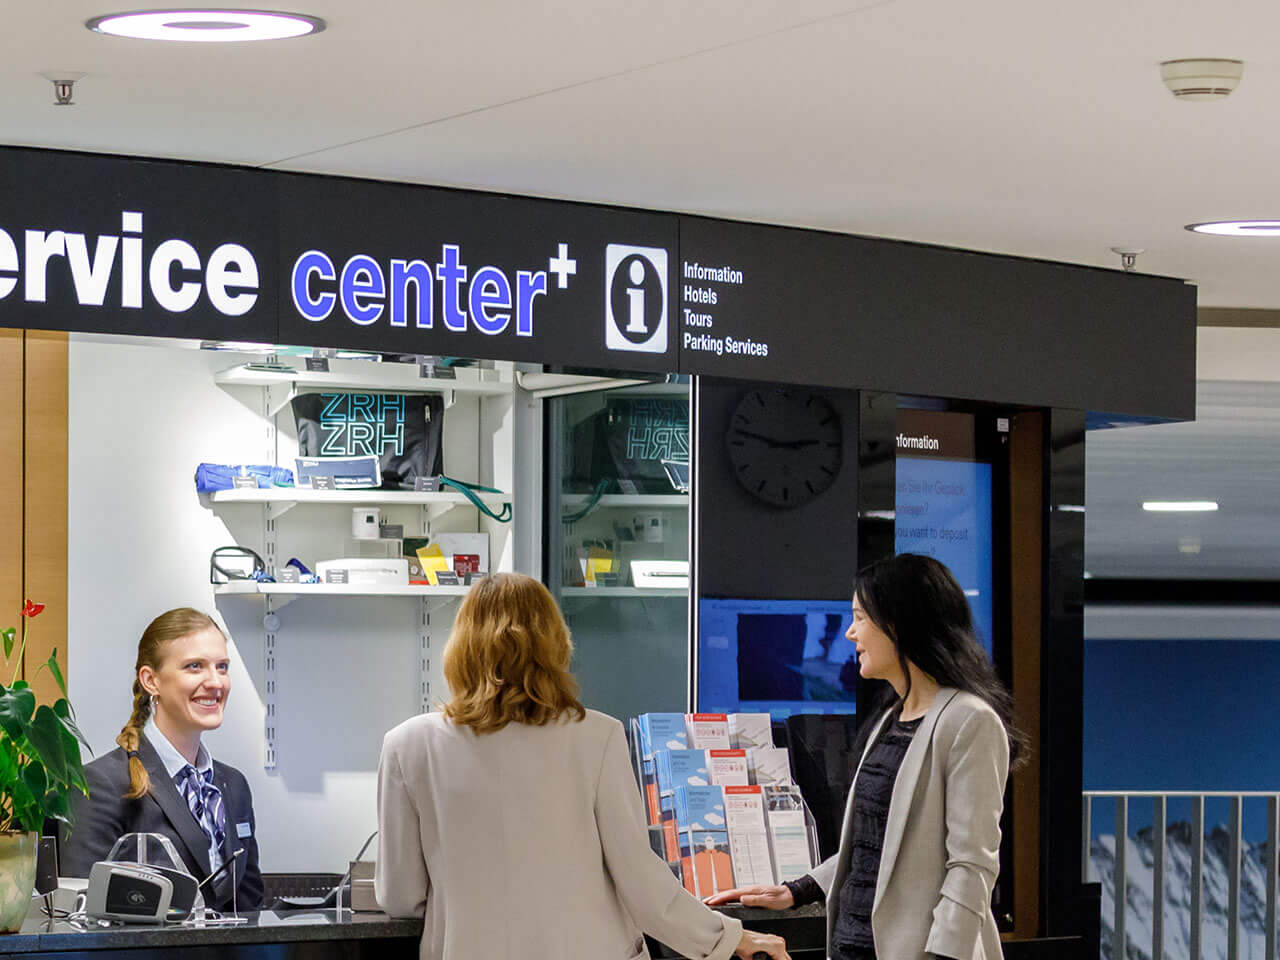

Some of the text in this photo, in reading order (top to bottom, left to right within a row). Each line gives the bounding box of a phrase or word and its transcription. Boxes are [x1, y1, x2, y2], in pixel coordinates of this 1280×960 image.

[683, 261, 744, 285] Information
[683, 285, 718, 305] Hotels
[683, 308, 713, 328] Tours
[683, 333, 769, 357] Parking Services
[319, 393, 406, 422] ZRH
[320, 421, 405, 457] ZRH
[896, 433, 939, 450] nformation
